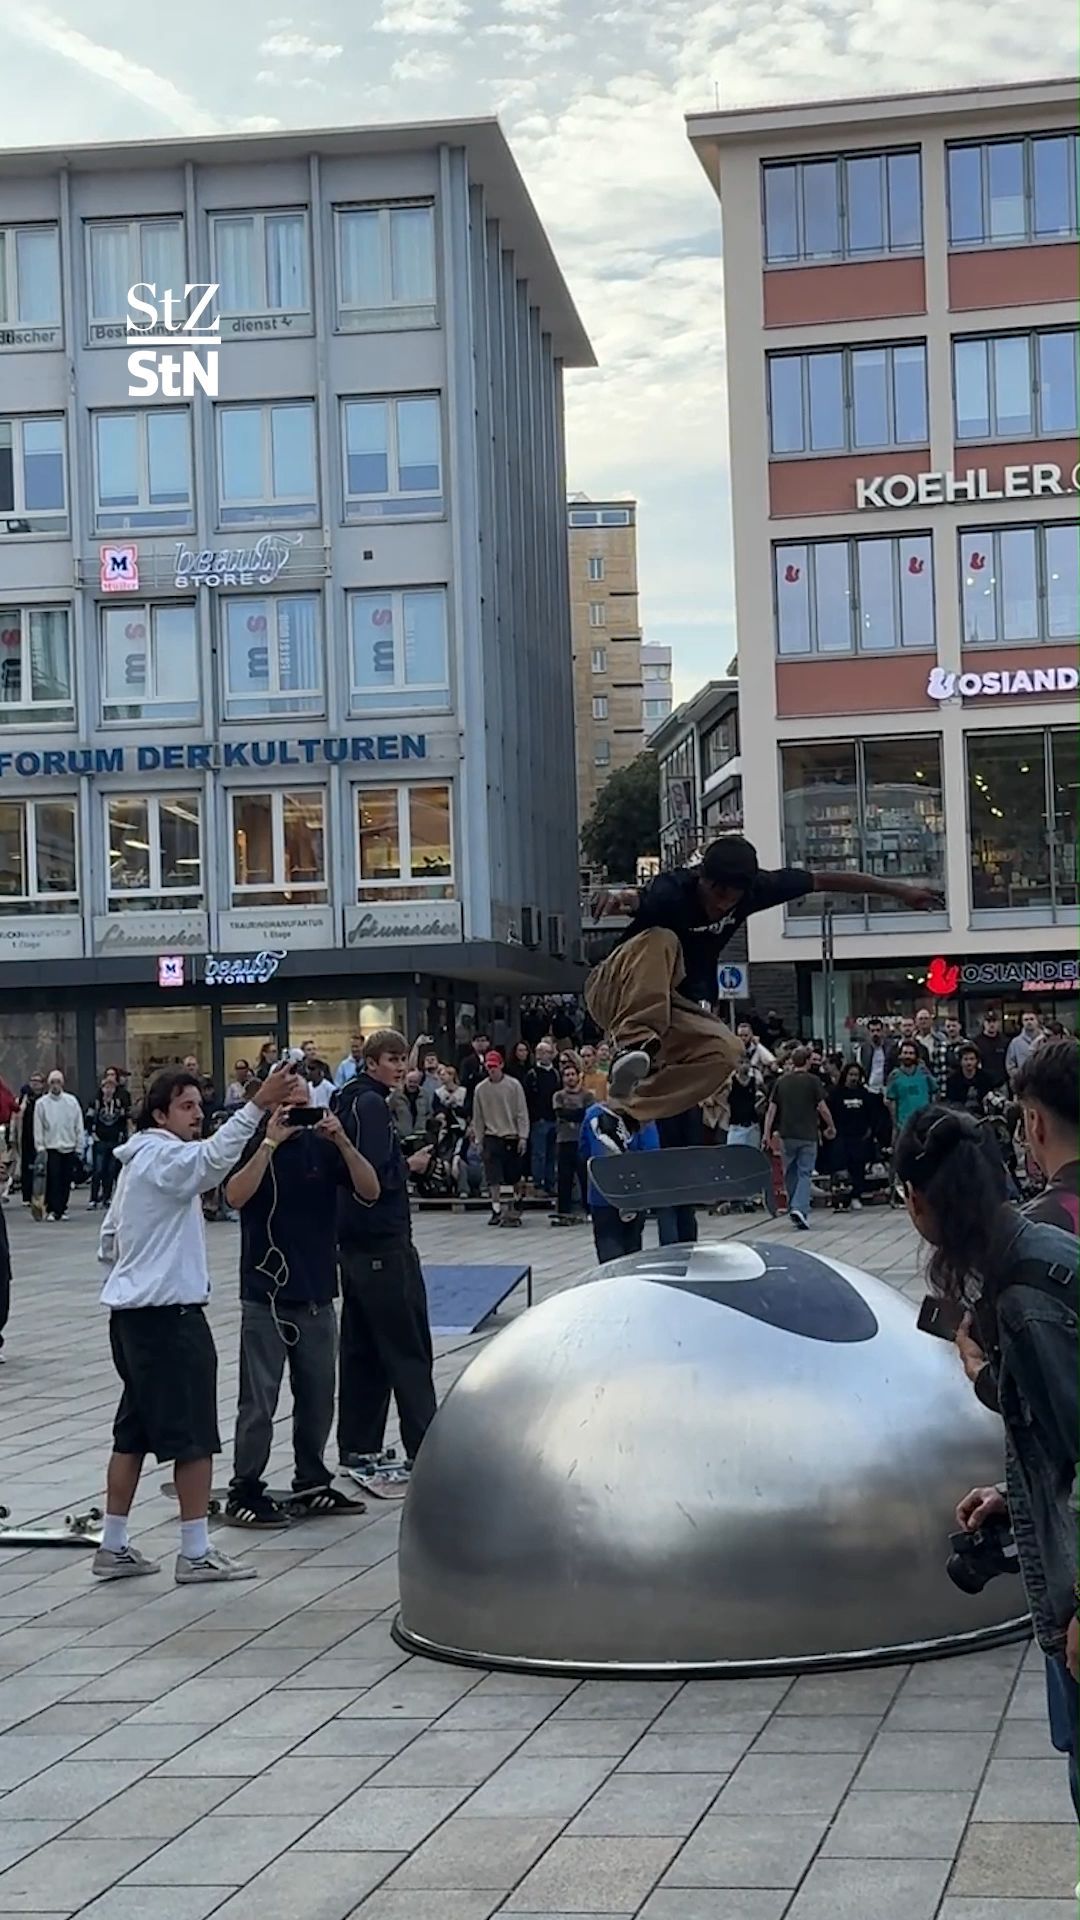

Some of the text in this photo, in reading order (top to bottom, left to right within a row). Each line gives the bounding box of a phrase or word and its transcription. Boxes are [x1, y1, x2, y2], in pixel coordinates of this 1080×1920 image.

[231, 317, 278, 333] dienst
[855, 462, 1080, 509] KOEHLER.
[174, 573, 254, 588] STORE
[137, 743, 211, 770] DER
[224, 734, 426, 767] KULTUREN
[205, 975, 255, 985] STORE
[962, 960, 1080, 983] OSIANDE
